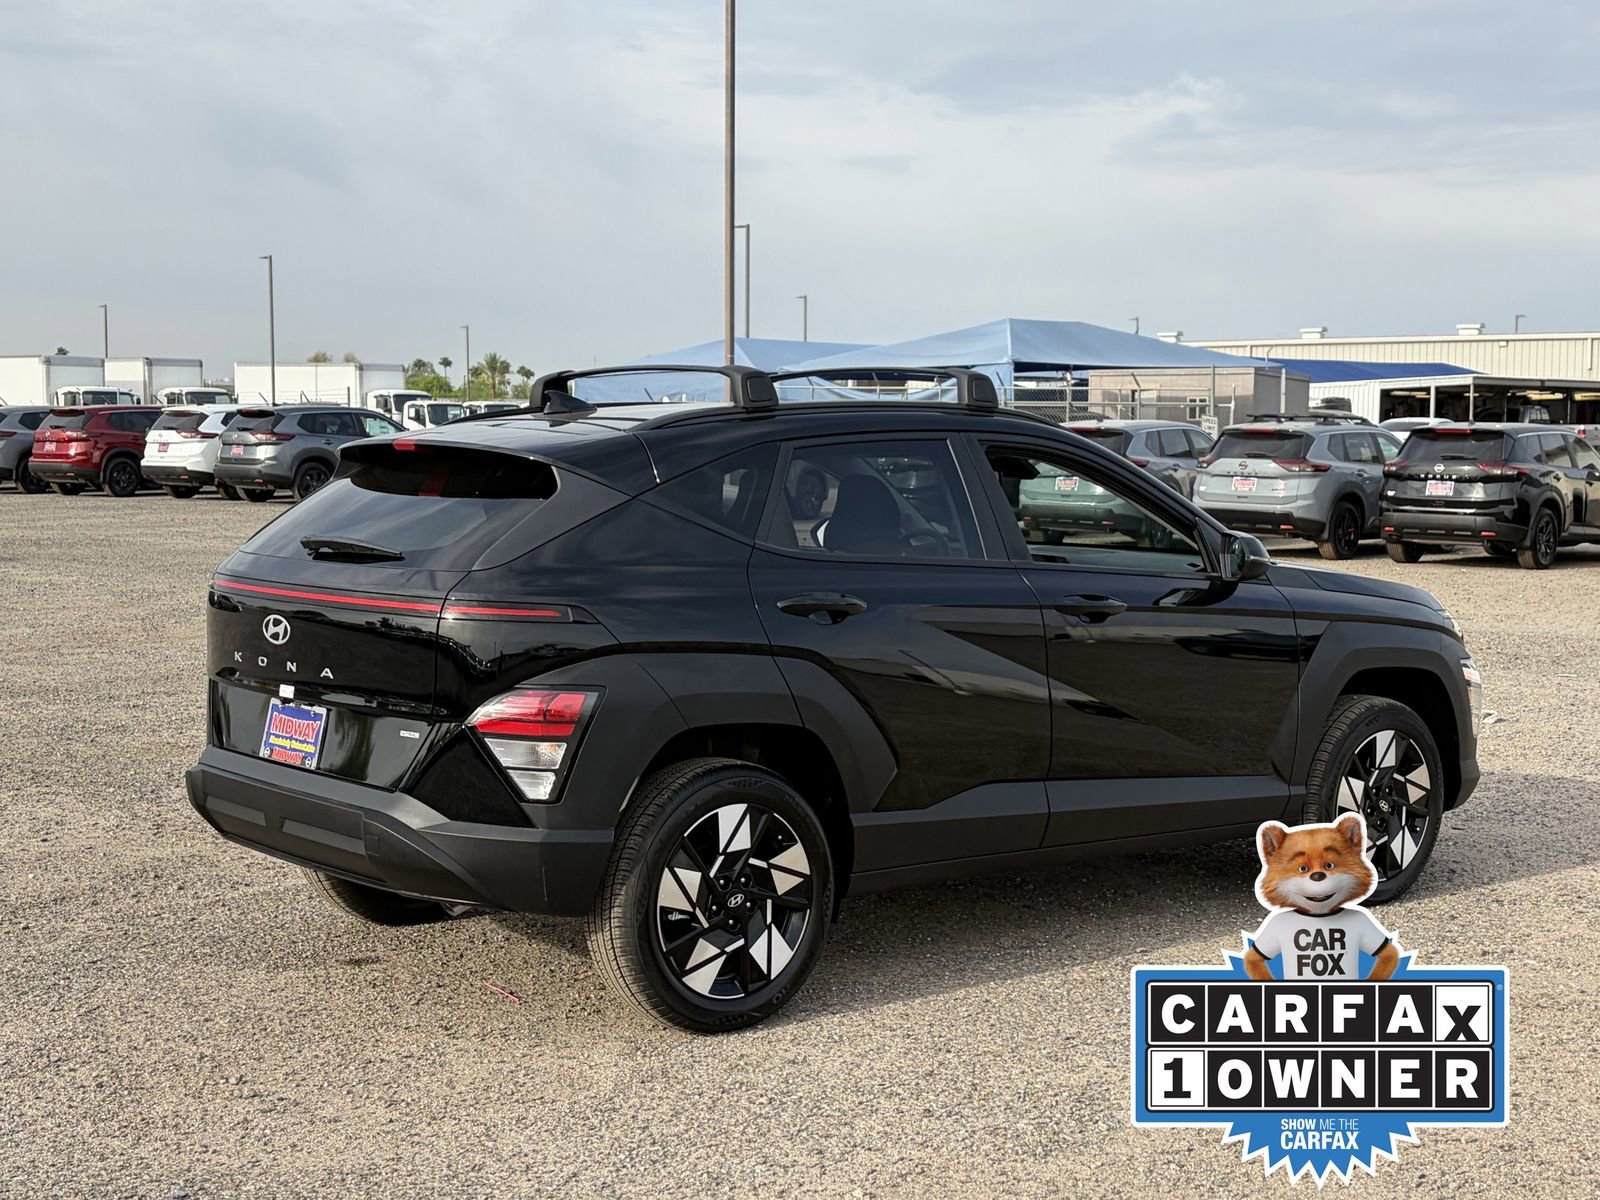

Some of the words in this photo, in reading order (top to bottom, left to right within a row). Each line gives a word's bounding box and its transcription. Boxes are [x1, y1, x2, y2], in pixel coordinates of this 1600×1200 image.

[234, 651, 334, 680] KONA
[270, 712, 321, 742] MIDWAY
[271, 747, 304, 765] MIDWAY
